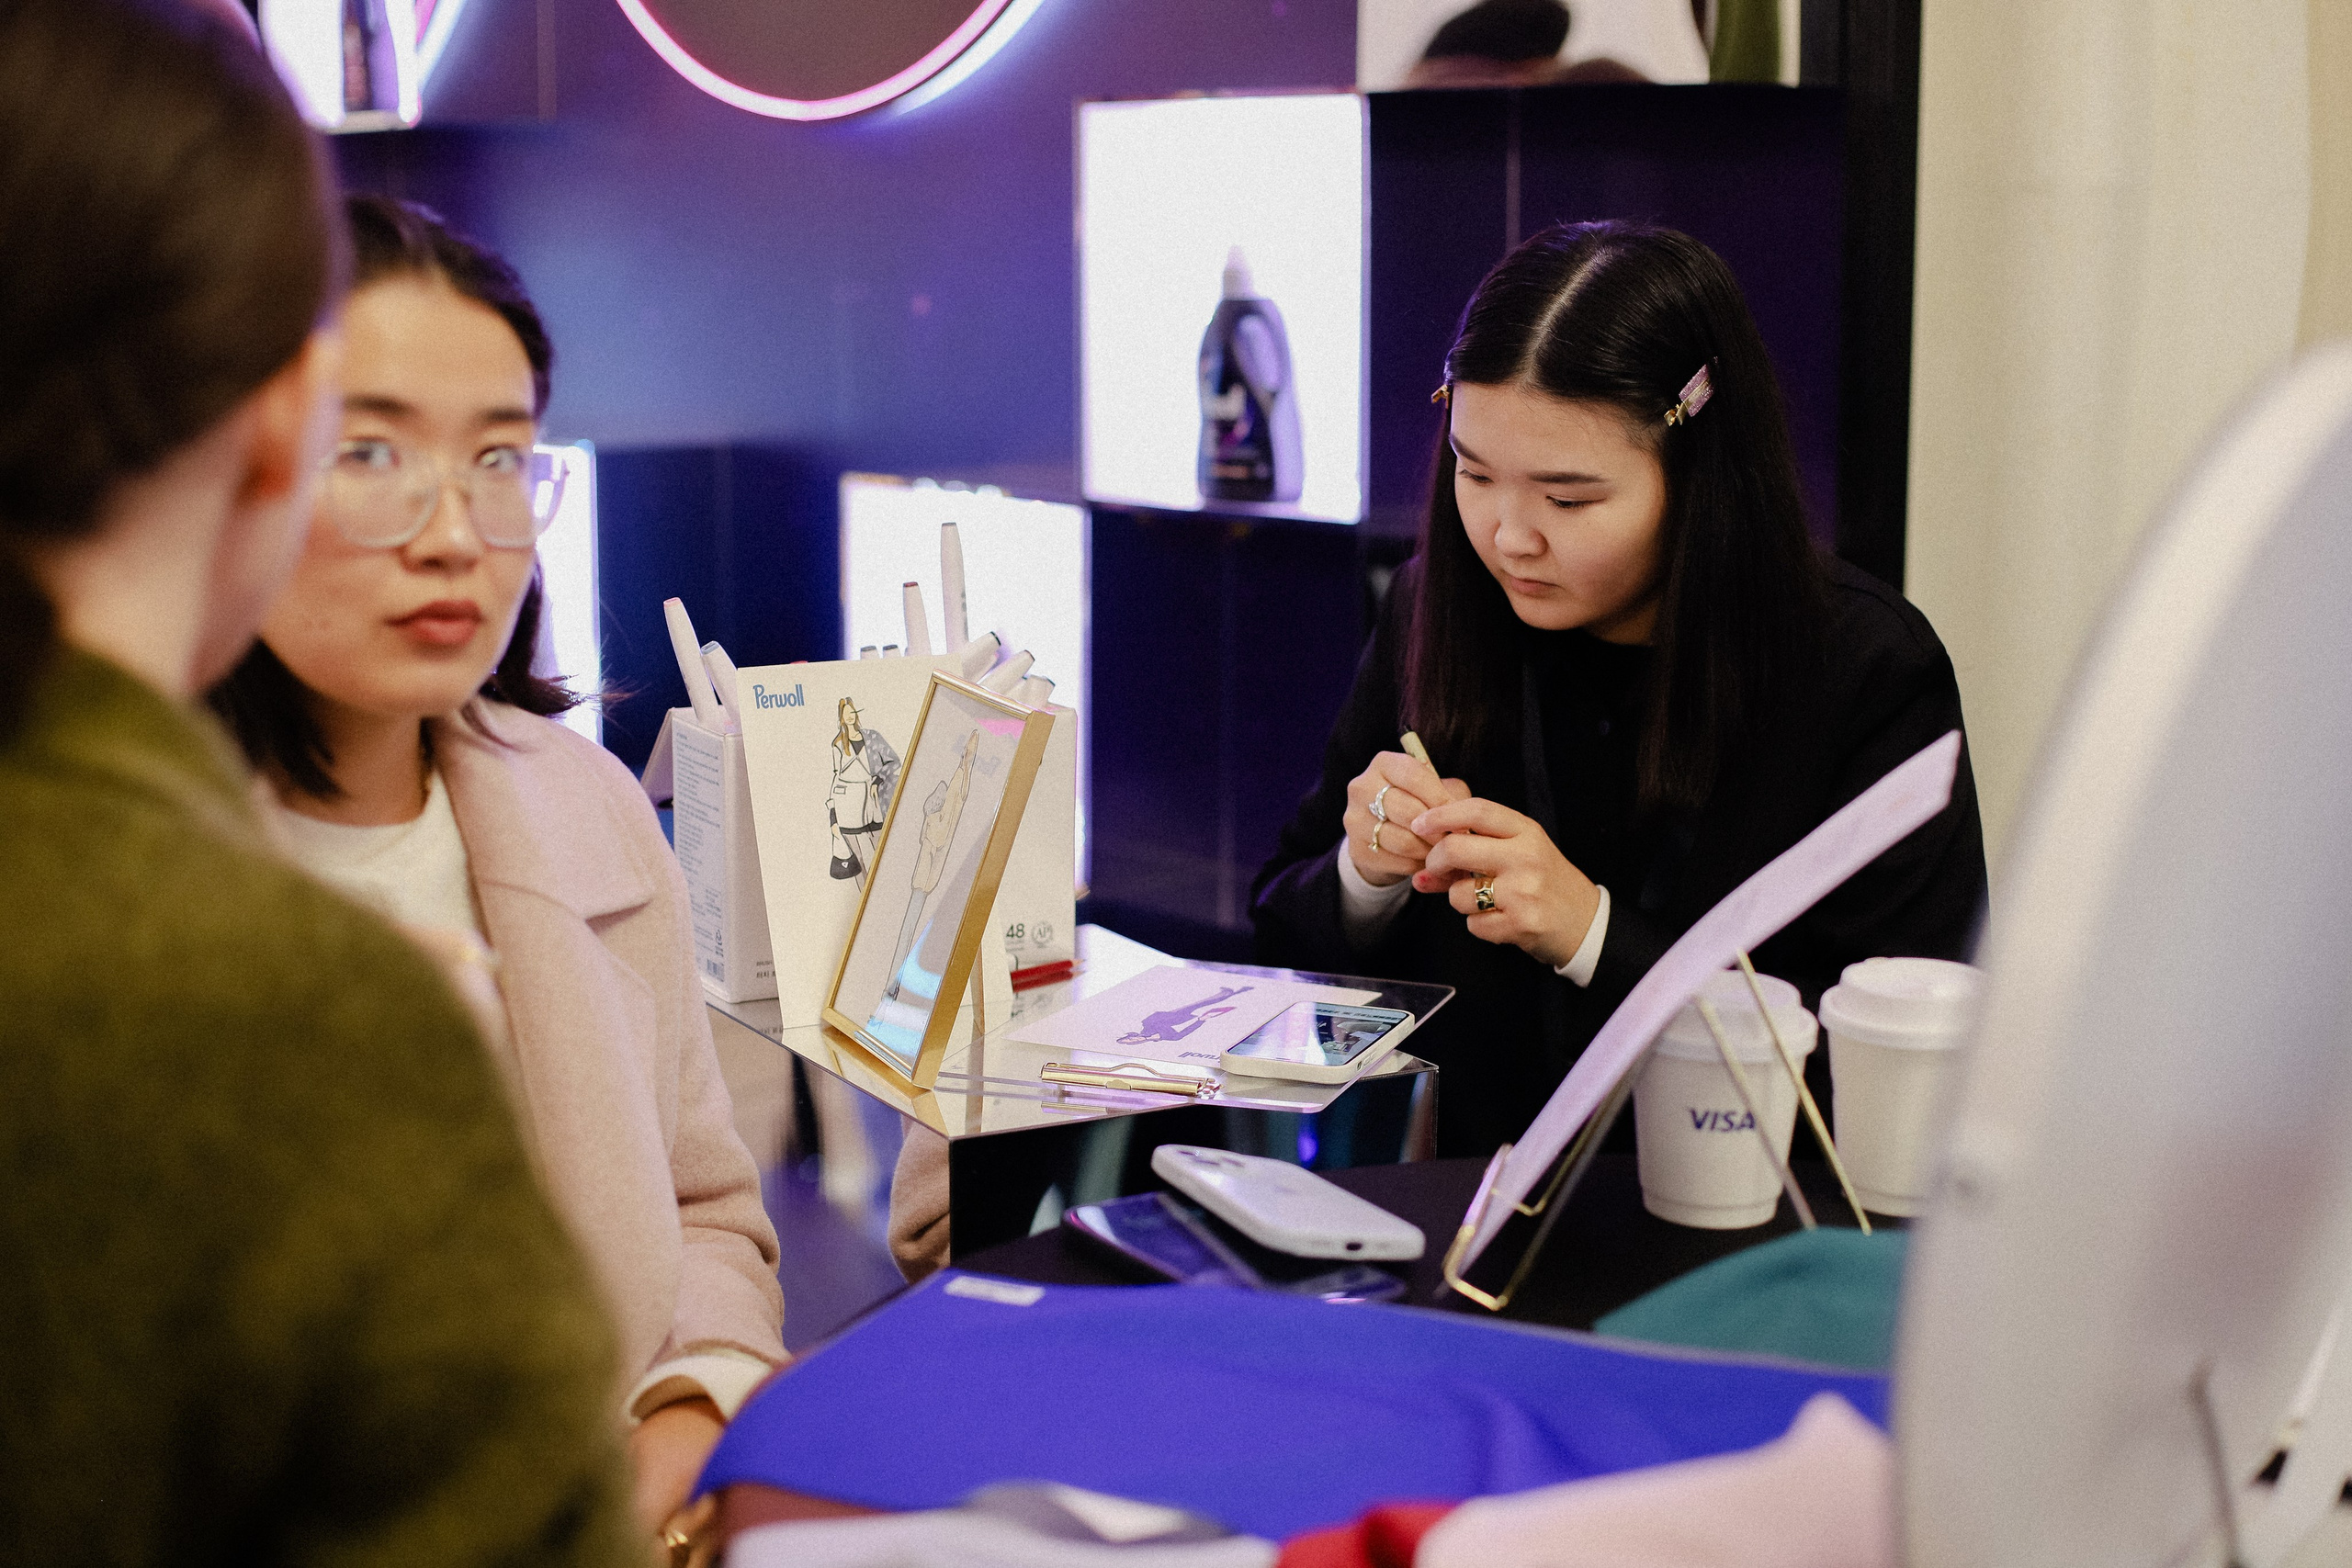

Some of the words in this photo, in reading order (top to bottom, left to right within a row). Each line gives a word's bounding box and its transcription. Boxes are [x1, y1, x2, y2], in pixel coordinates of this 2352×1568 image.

[752, 683, 805, 709] Perwoll
[1006, 923, 1025, 939] 48
[1178, 1051, 1220, 1063] rwoll
[1689, 1108, 1756, 1132] VISA
